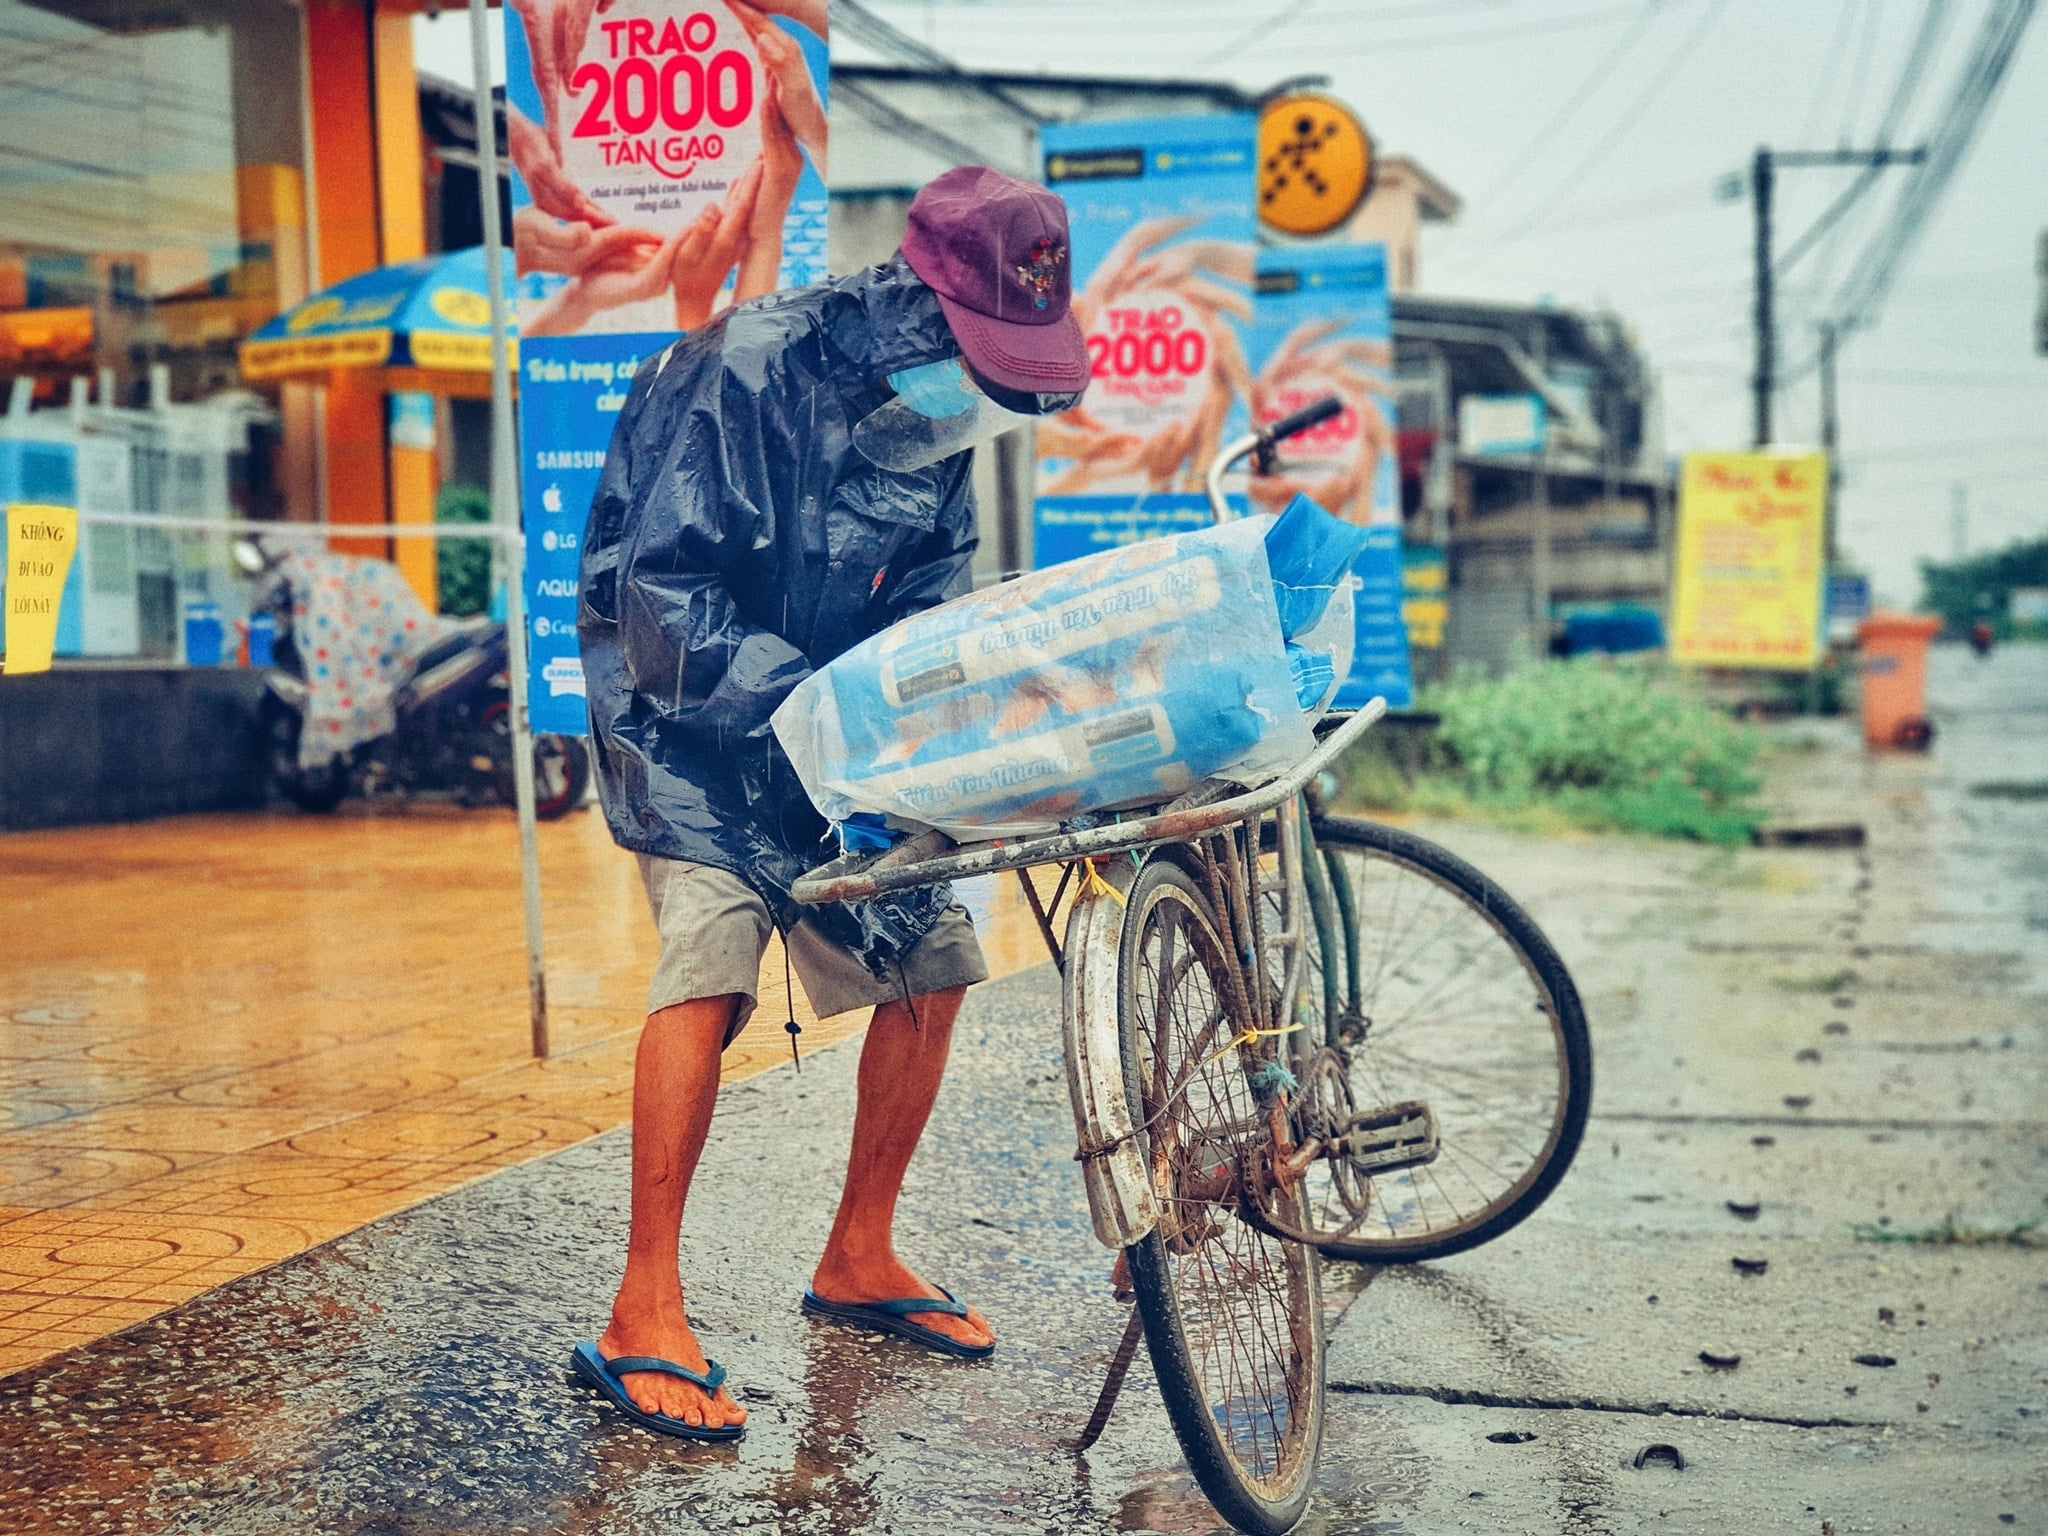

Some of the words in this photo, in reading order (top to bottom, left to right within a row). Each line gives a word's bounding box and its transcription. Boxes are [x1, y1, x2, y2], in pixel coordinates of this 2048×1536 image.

[601, 12, 716, 58] TRAO
[663, 132, 725, 167] GẠO
[1107, 306, 1183, 331] TRAO
[1086, 329, 1205, 378] 2000
[536, 450, 607, 470] SAMSUN
[559, 532, 577, 549] LG
